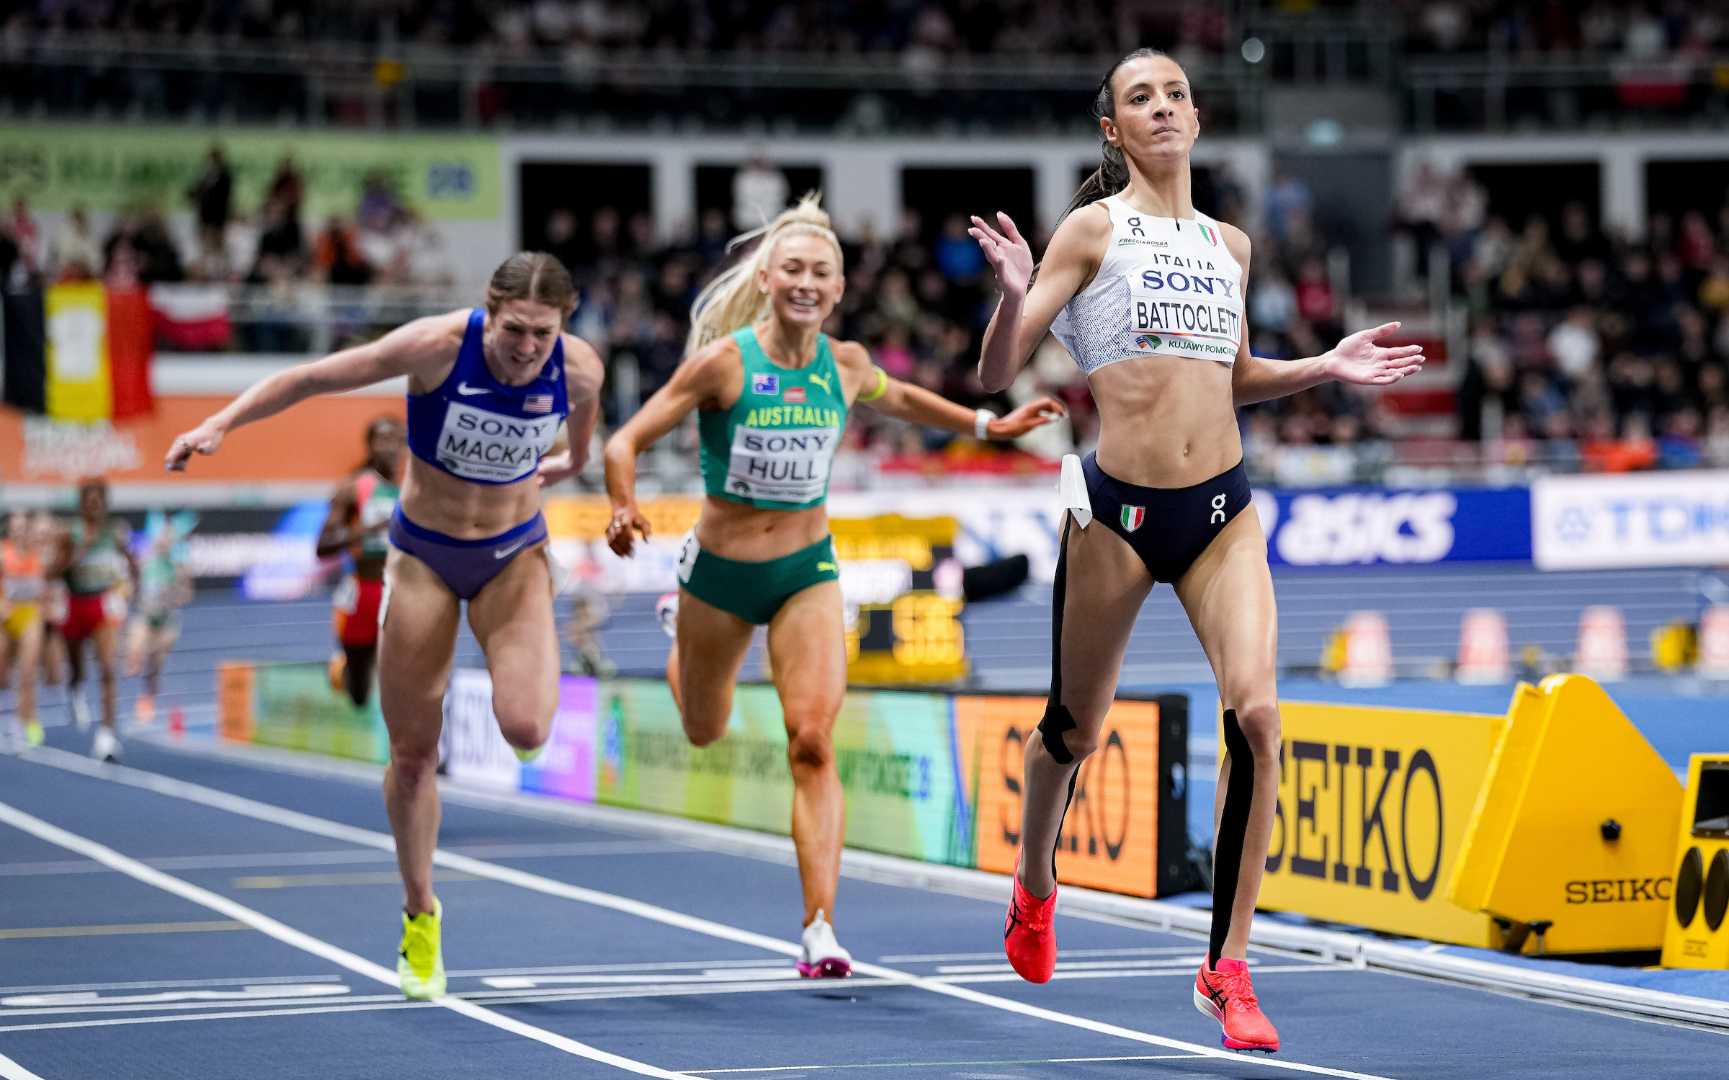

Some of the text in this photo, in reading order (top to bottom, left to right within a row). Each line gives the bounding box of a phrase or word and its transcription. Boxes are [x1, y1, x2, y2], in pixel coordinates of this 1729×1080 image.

[1141, 270, 1234, 298] SONY
[1168, 340, 1205, 352] KUJAWY
[457, 413, 549, 438] SONY
[745, 405, 840, 428] AUSTRALIA
[745, 435, 829, 453] SONY
[748, 457, 818, 481] HULL
